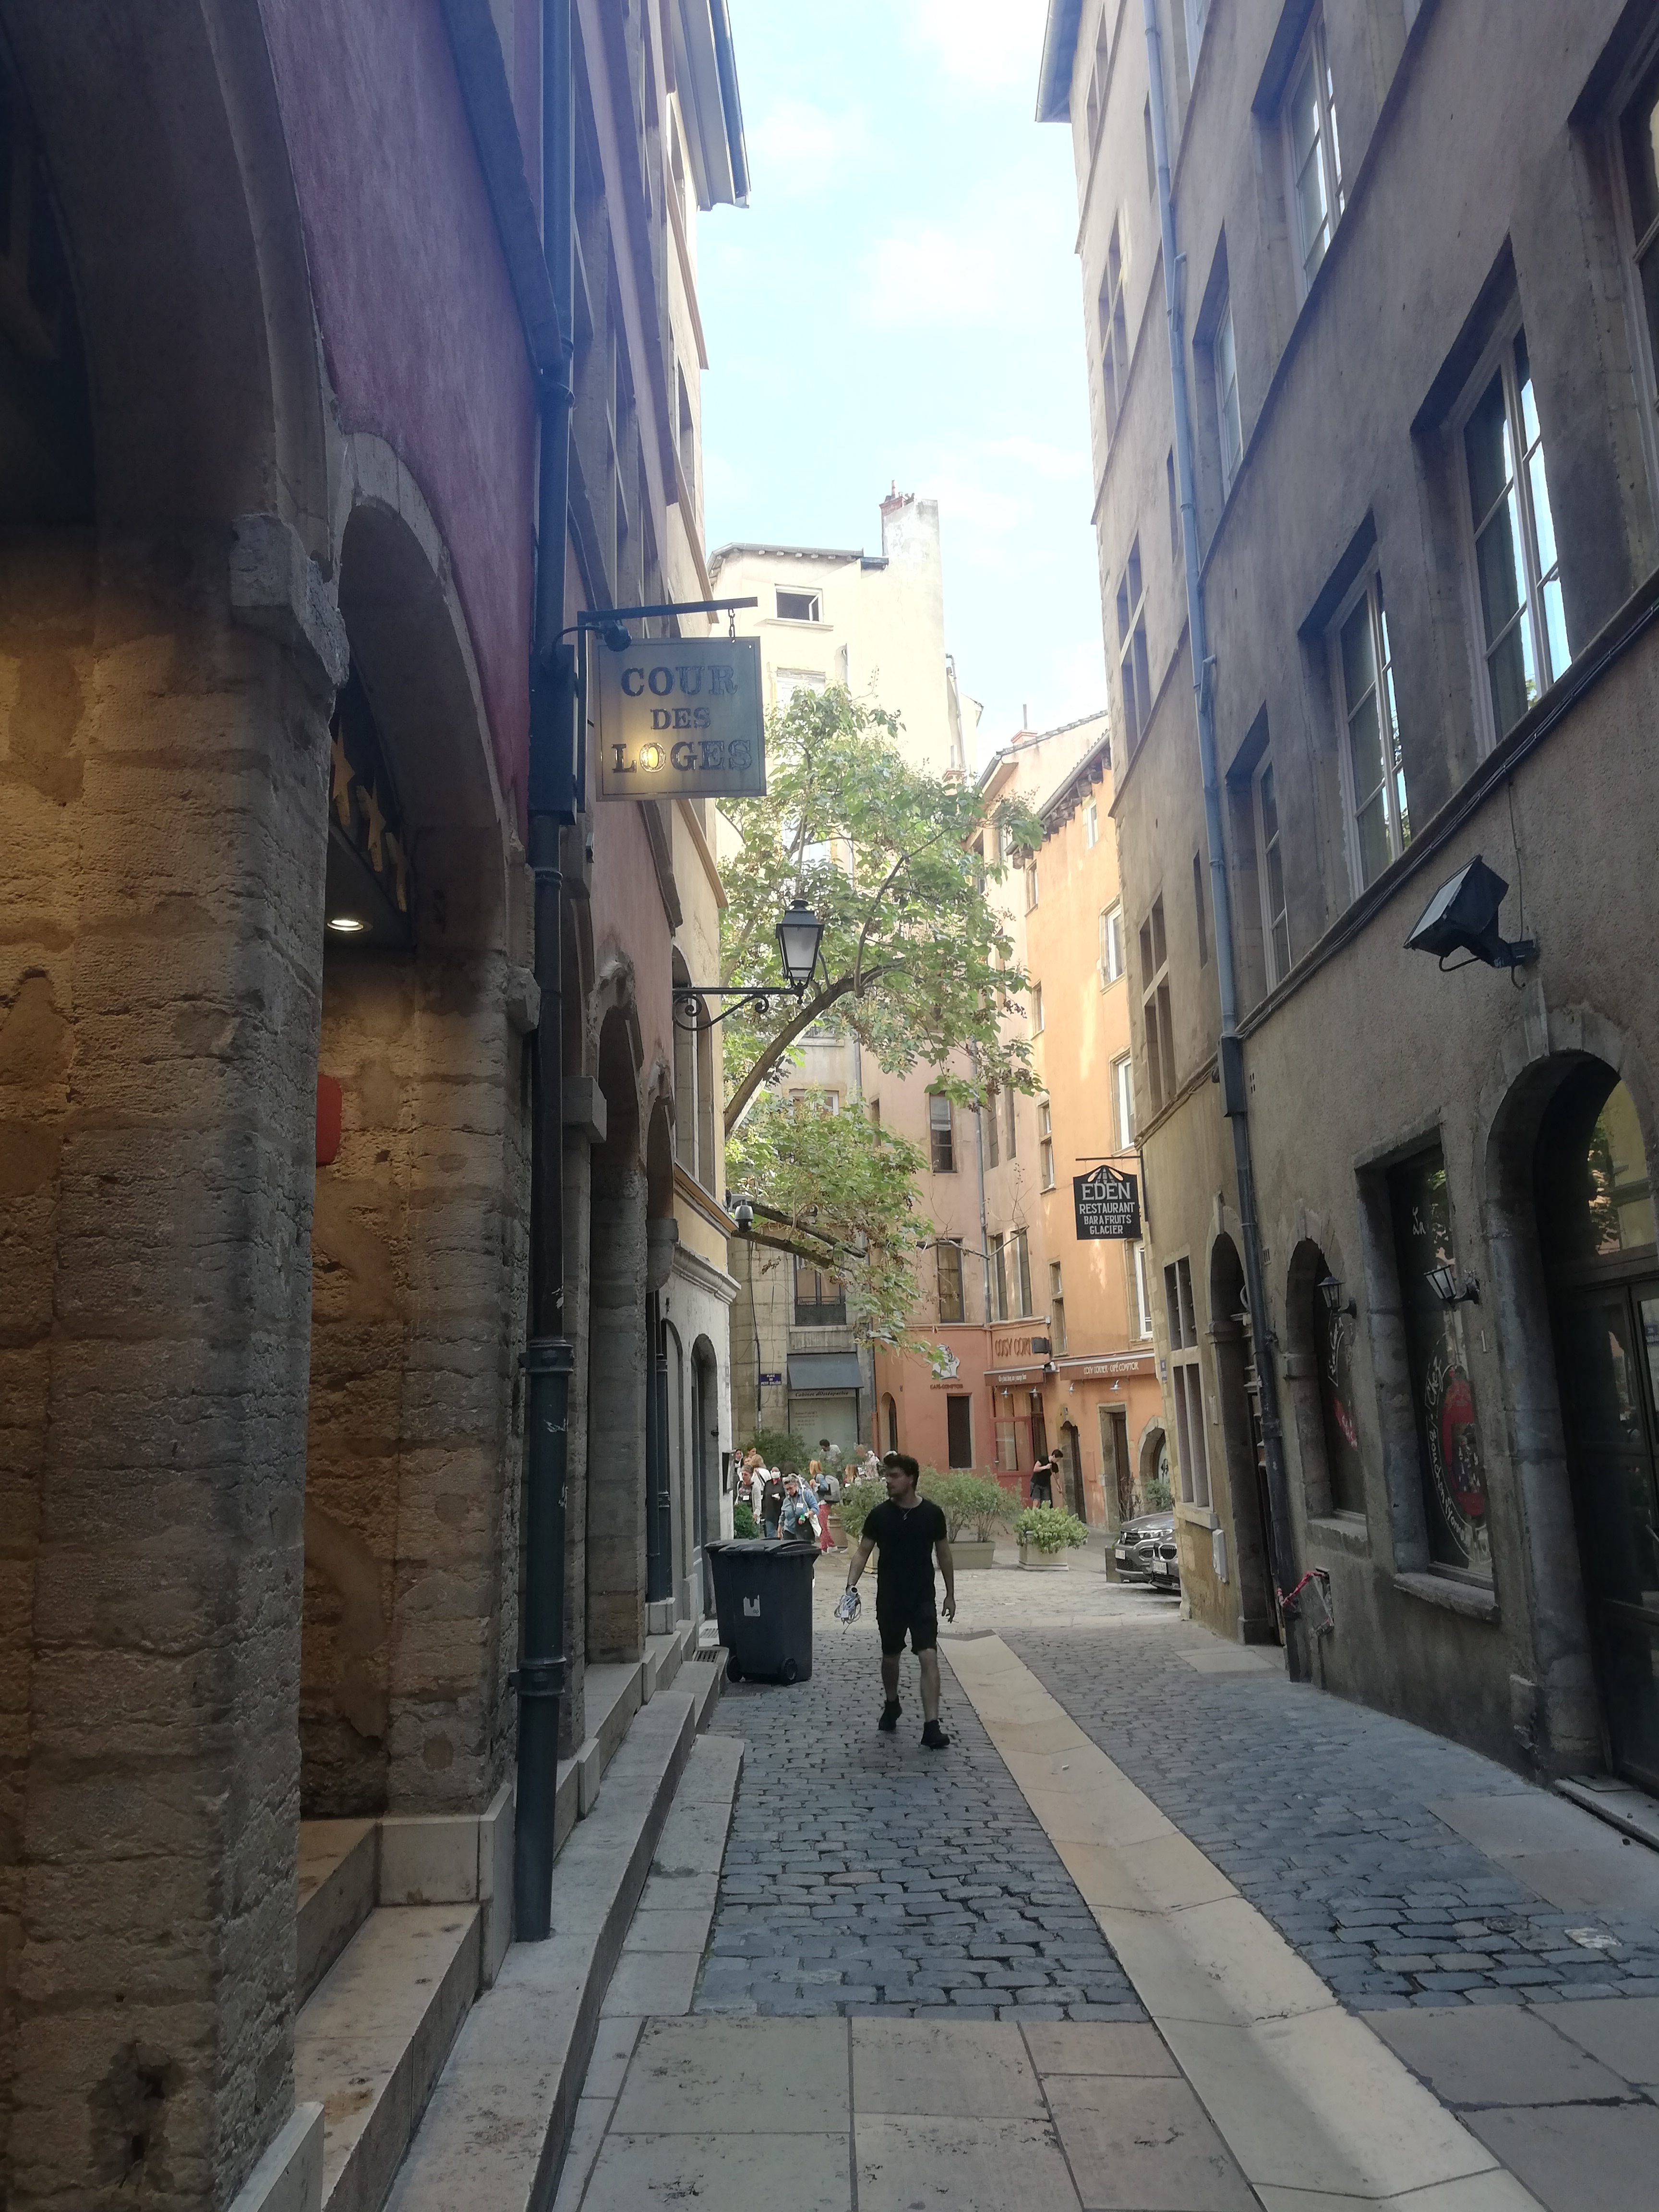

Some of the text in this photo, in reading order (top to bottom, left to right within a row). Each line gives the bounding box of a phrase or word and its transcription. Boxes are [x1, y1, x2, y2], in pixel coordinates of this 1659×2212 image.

[621, 665, 738, 697] COUR
[650, 708, 711, 730] DES
[611, 740, 753, 774] LOGES
[1081, 1182, 1131, 1200] EDEN
[1079, 1202, 1135, 1214] RESTAURANT
[1084, 1215, 1098, 1225] BAR
[1105, 1214, 1132, 1225] FRUITS
[1089, 1225, 1123, 1235] GLACIER
[995, 1338, 1012, 1357] COSY
